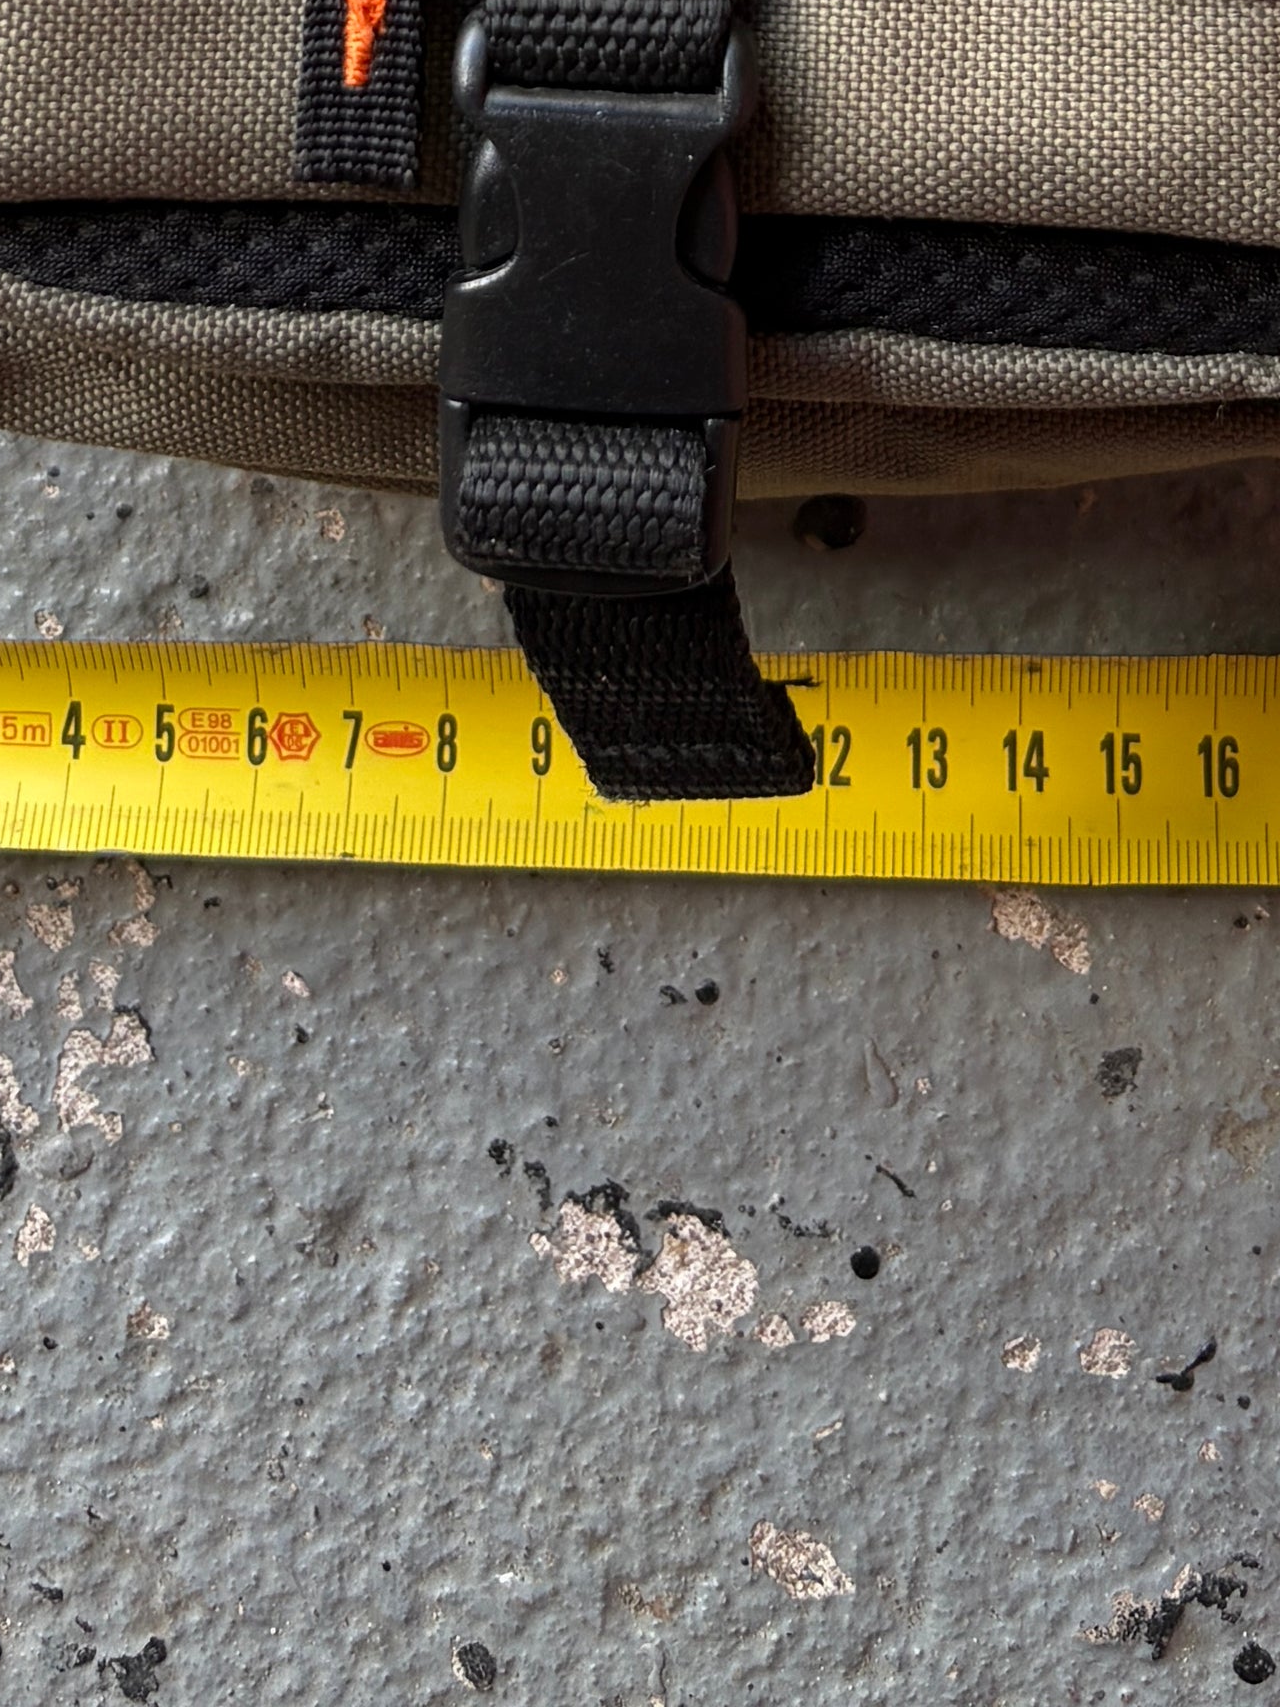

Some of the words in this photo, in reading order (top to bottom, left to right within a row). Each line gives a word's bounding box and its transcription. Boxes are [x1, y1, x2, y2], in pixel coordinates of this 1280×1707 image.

[61, 701, 86, 760] 4
[155, 704, 175, 762] 5
[247, 707, 268, 766] 6
[342, 710, 363, 769] 7
[437, 713, 457, 773] 8
[531, 717, 552, 776] 9
[811, 724, 851, 786] 12
[906, 728, 948, 789] 13
[1002, 730, 1050, 793] 14
[1099, 732, 1143, 796] 15
[1197, 734, 1240, 800] 16
[103, 719, 130, 744] II
